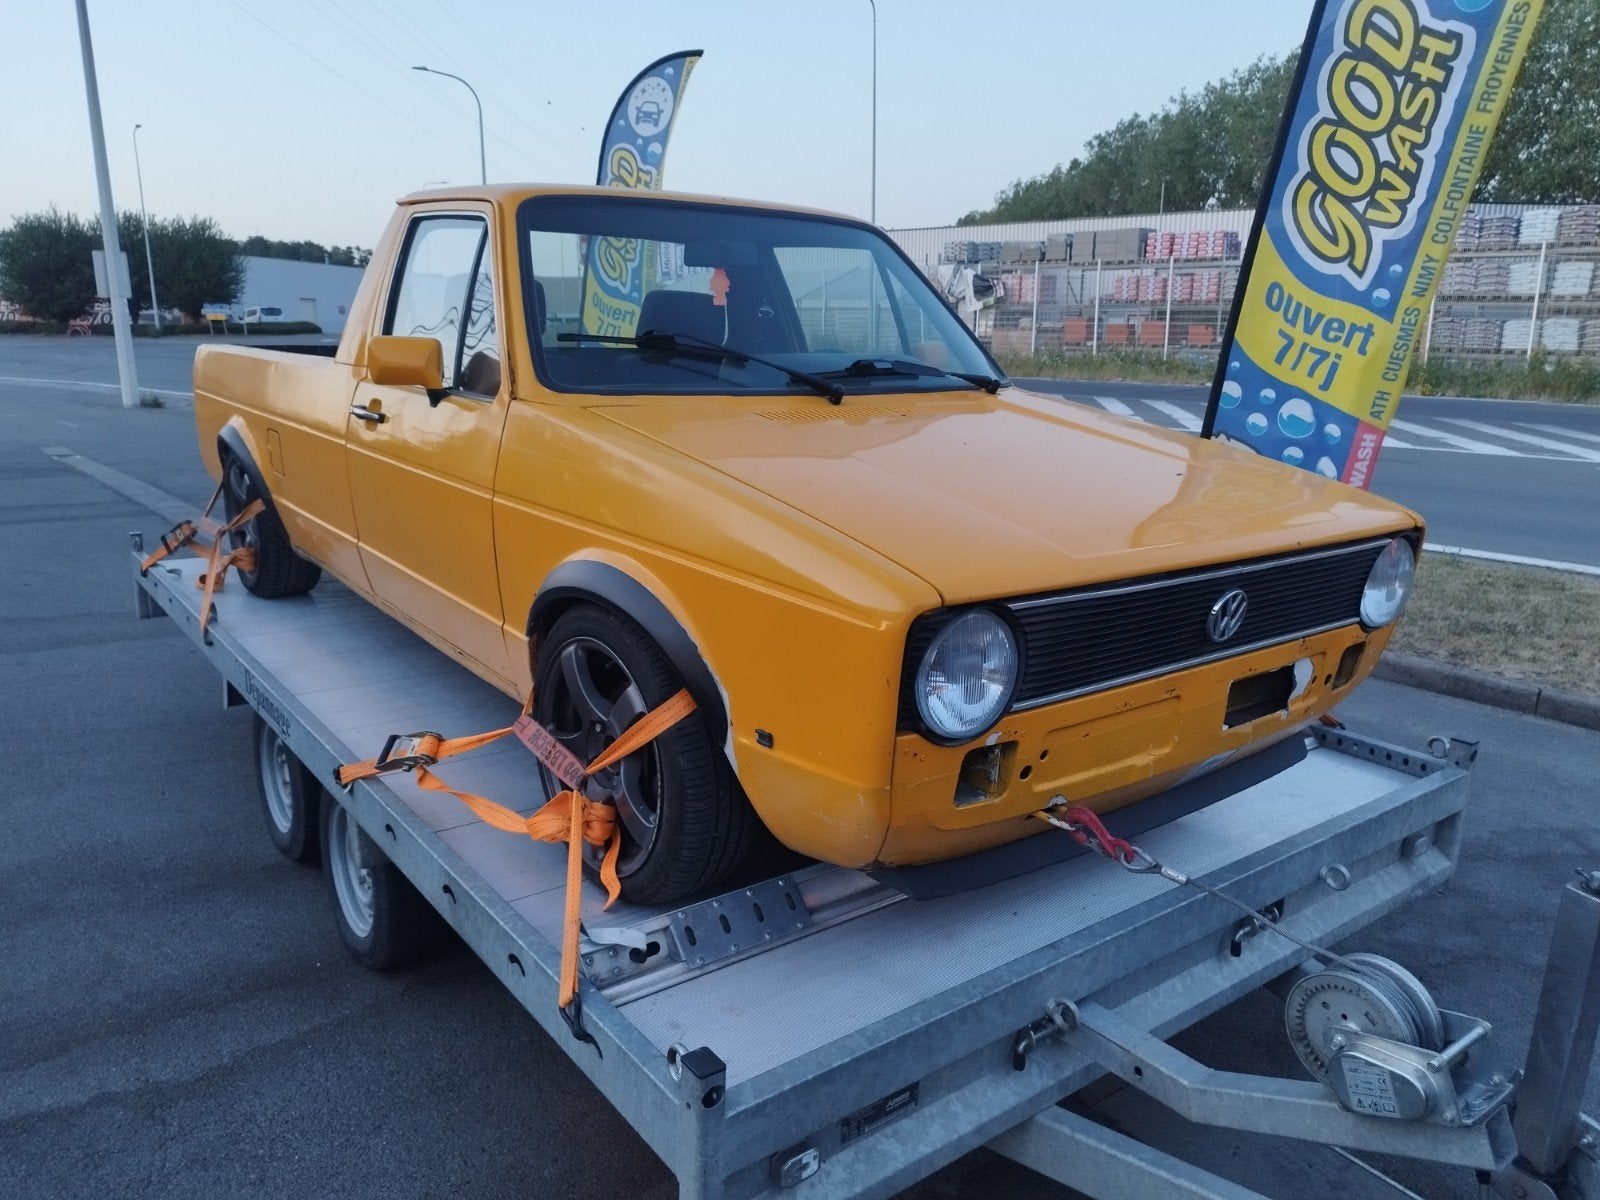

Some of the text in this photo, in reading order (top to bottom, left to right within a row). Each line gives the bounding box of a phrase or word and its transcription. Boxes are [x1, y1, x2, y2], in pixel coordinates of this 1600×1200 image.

[1293, 0, 1418, 277] GOOD
[1361, 29, 1459, 227] WASH
[1369, 1, 1531, 420] ATH CUESMES NIMY COLFONTAINE FROYENNES
[592, 292, 636, 326] ouvert
[1265, 281, 1375, 356] ouvert
[1274, 328, 1342, 391] 7/7j
[1348, 433, 1377, 487] WASH
